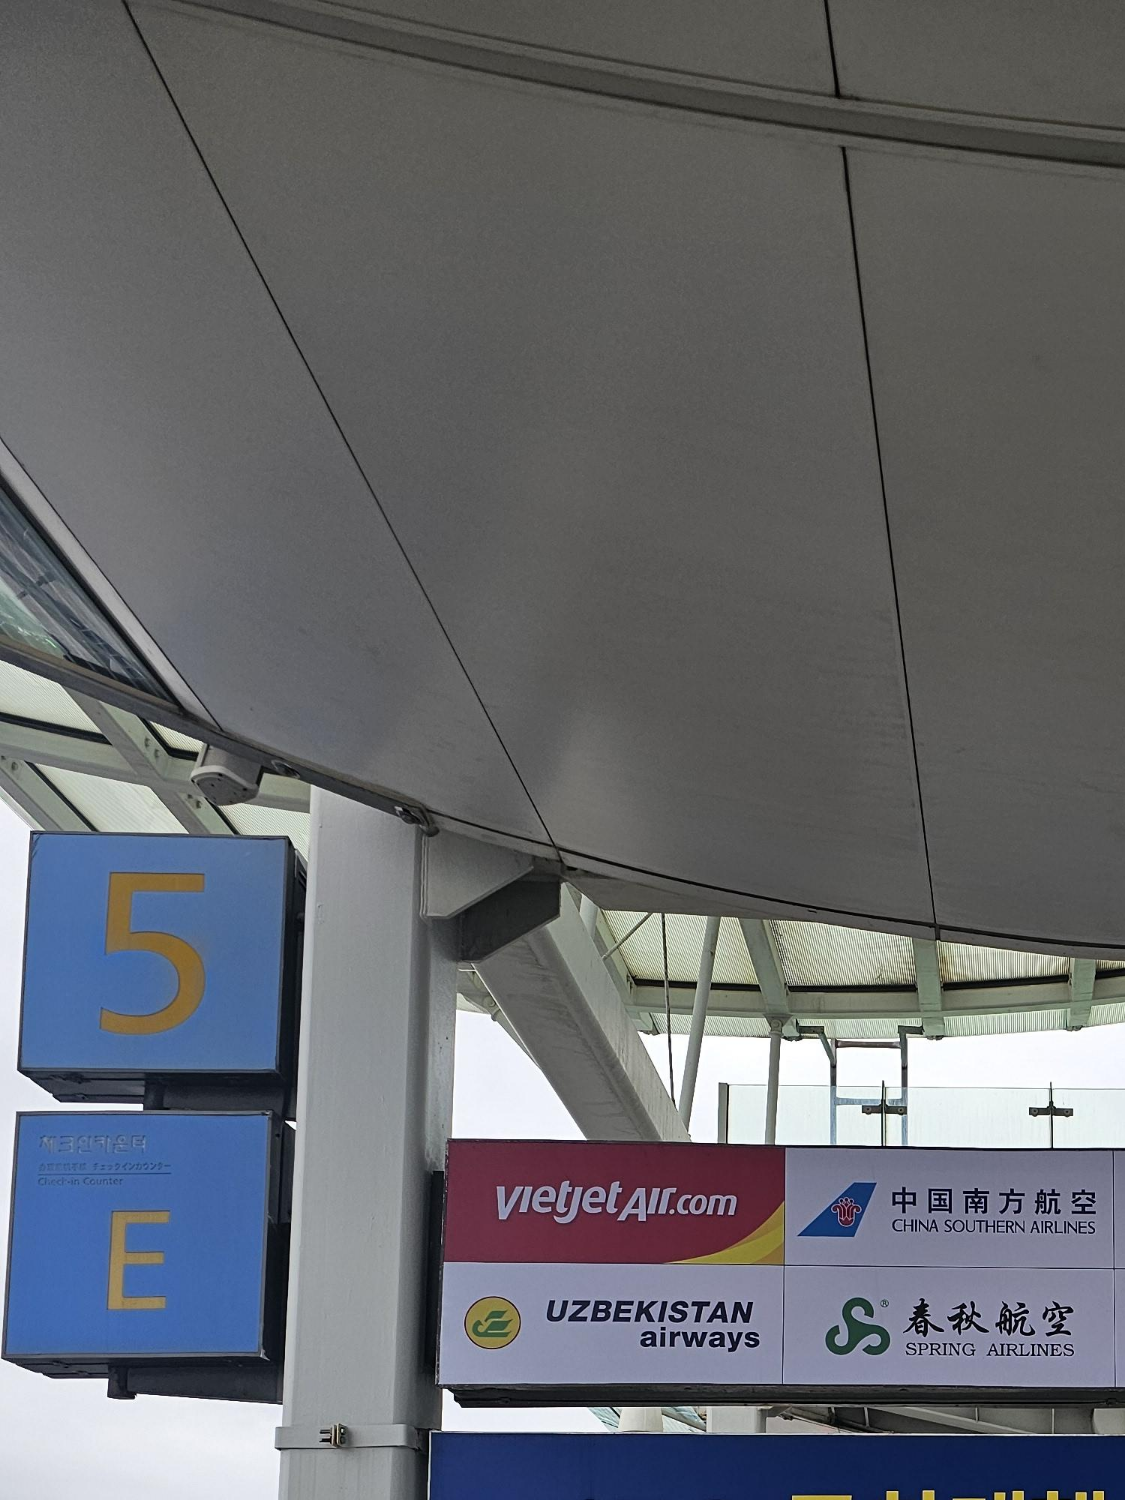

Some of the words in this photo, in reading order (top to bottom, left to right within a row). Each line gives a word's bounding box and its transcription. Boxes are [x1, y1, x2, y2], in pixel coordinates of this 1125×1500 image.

[99, 871, 206, 1036] 5
[39, 1134, 147, 1154] 체크인카운터
[38, 1177, 80, 1186] Check-in
[83, 1177, 124, 1186] Counter
[891, 1186, 1097, 1216] 中国南方航空
[892, 1218, 939, 1234] CHINA
[944, 1219, 1026, 1234] SOUTHERN
[1030, 1220, 1096, 1235] AIRLINES
[106, 1210, 171, 1310] E
[546, 1299, 754, 1324] UZBEKISTAN
[903, 1297, 1075, 1338] 春秋航空
[639, 1326, 760, 1353] airways
[905, 1342, 976, 1357] SPRING
[986, 1342, 1075, 1357] AIRLINES
